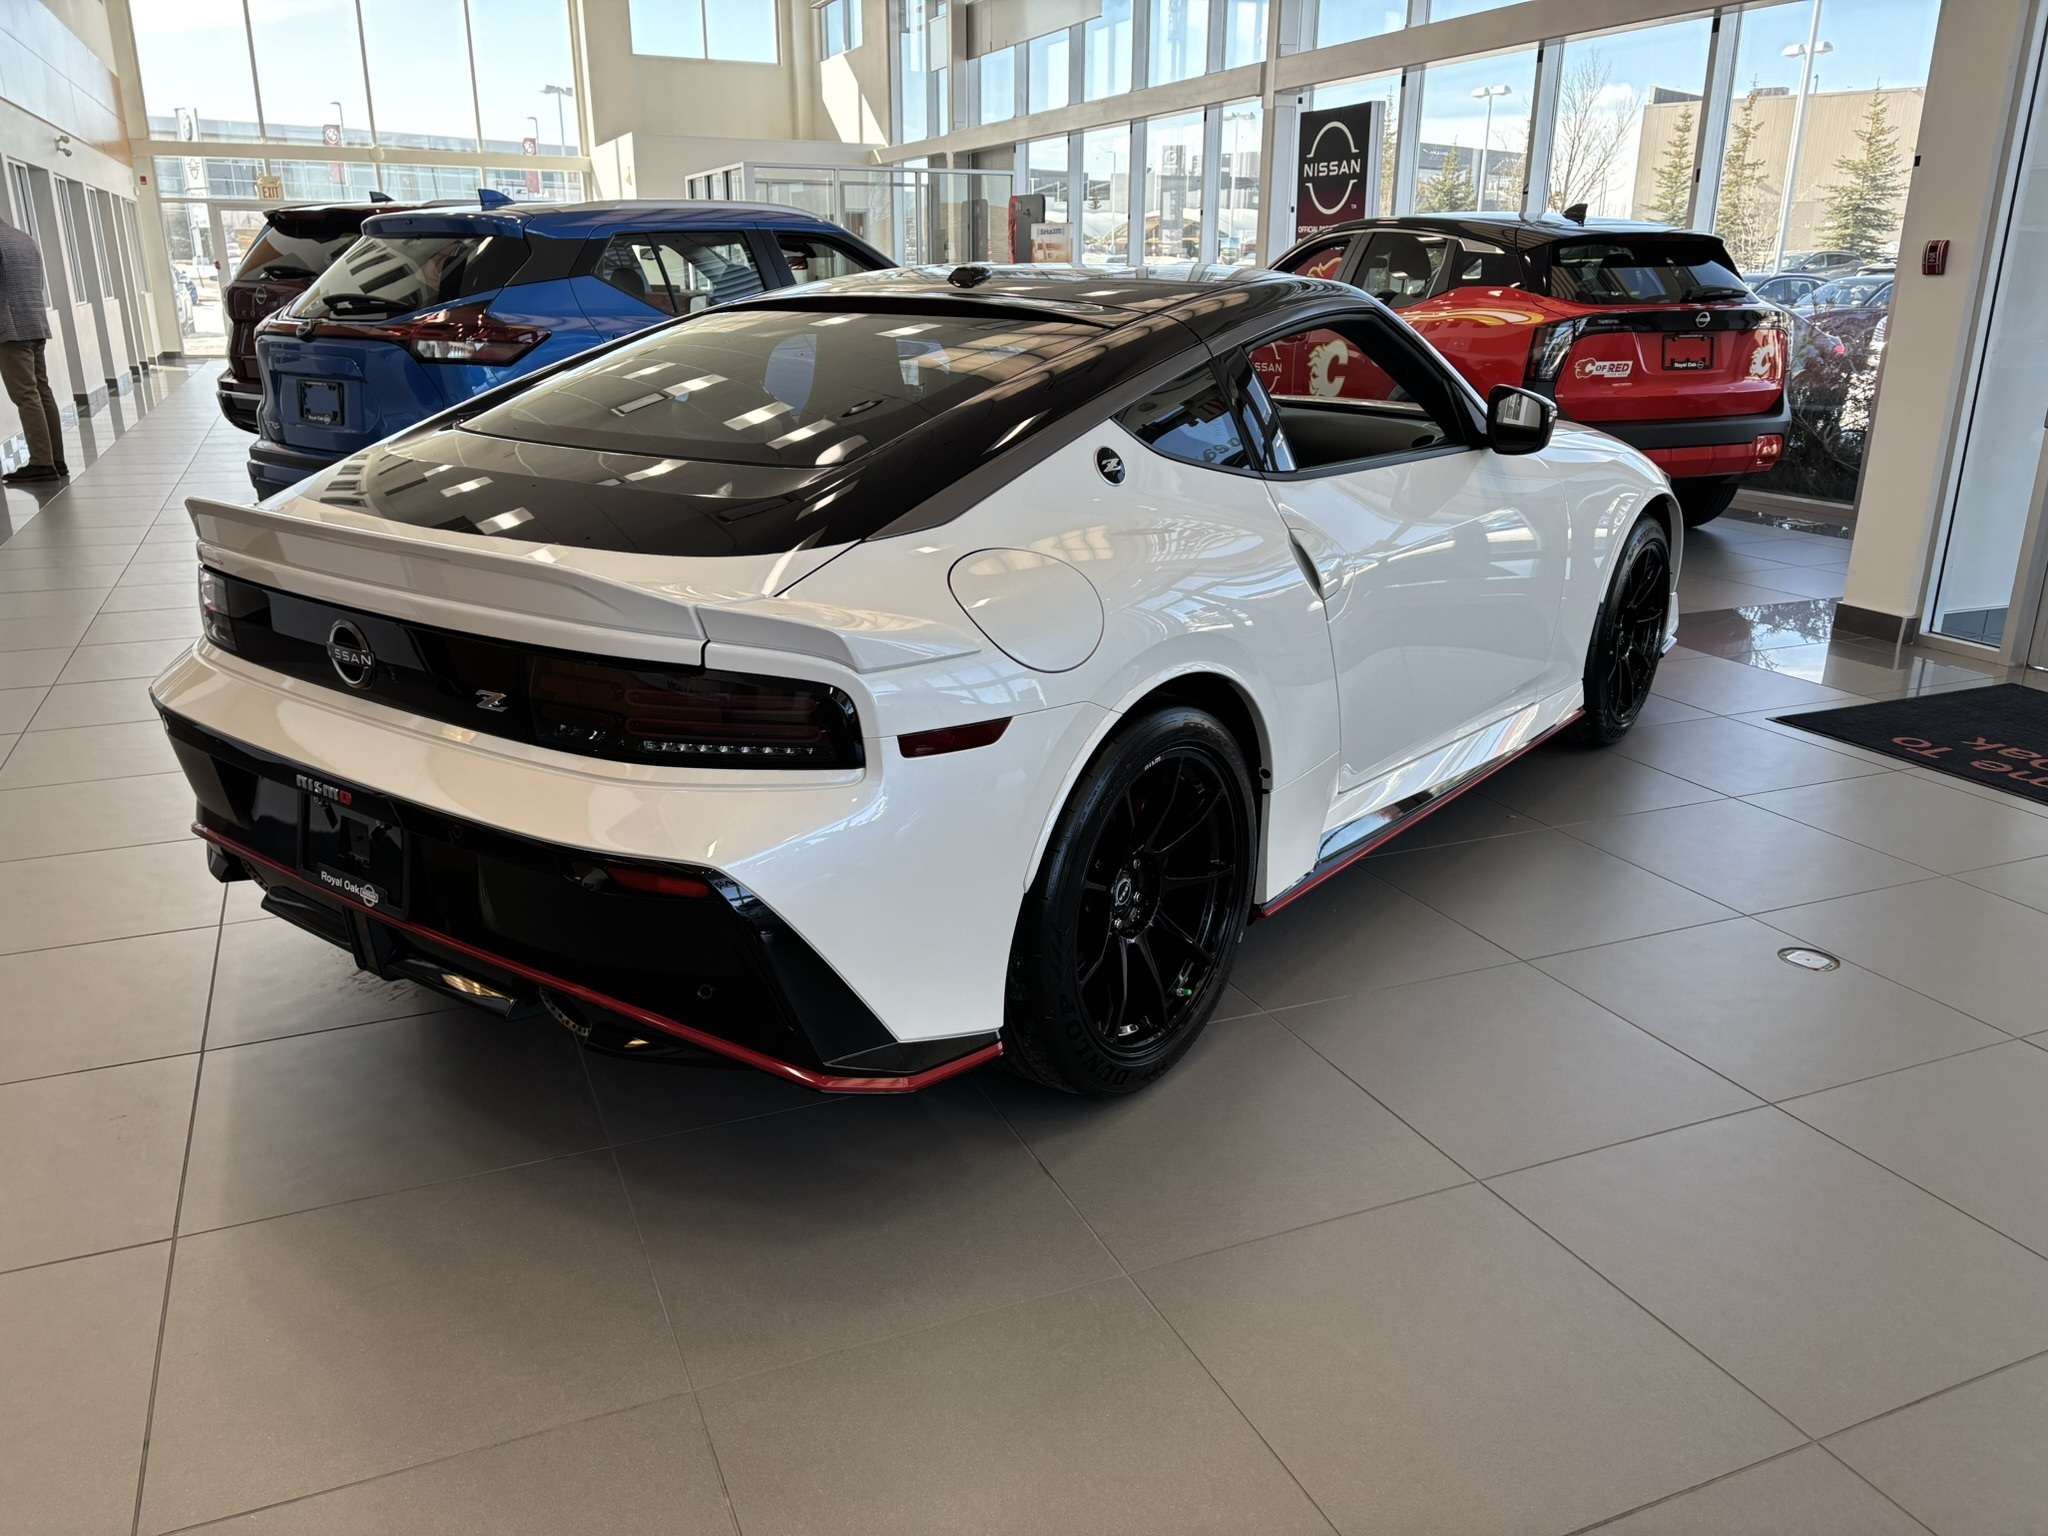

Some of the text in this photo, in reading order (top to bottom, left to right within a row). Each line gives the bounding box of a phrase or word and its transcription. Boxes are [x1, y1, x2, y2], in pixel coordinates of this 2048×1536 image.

[1303, 158, 1361, 178] NISSAN
[262, 186, 279, 198] EXIT
[1254, 361, 1282, 373] SSAN
[1608, 362, 1630, 373] RED
[333, 647, 372, 666] SSAN
[321, 870, 343, 887] Royal
[344, 880, 360, 895] Oak
